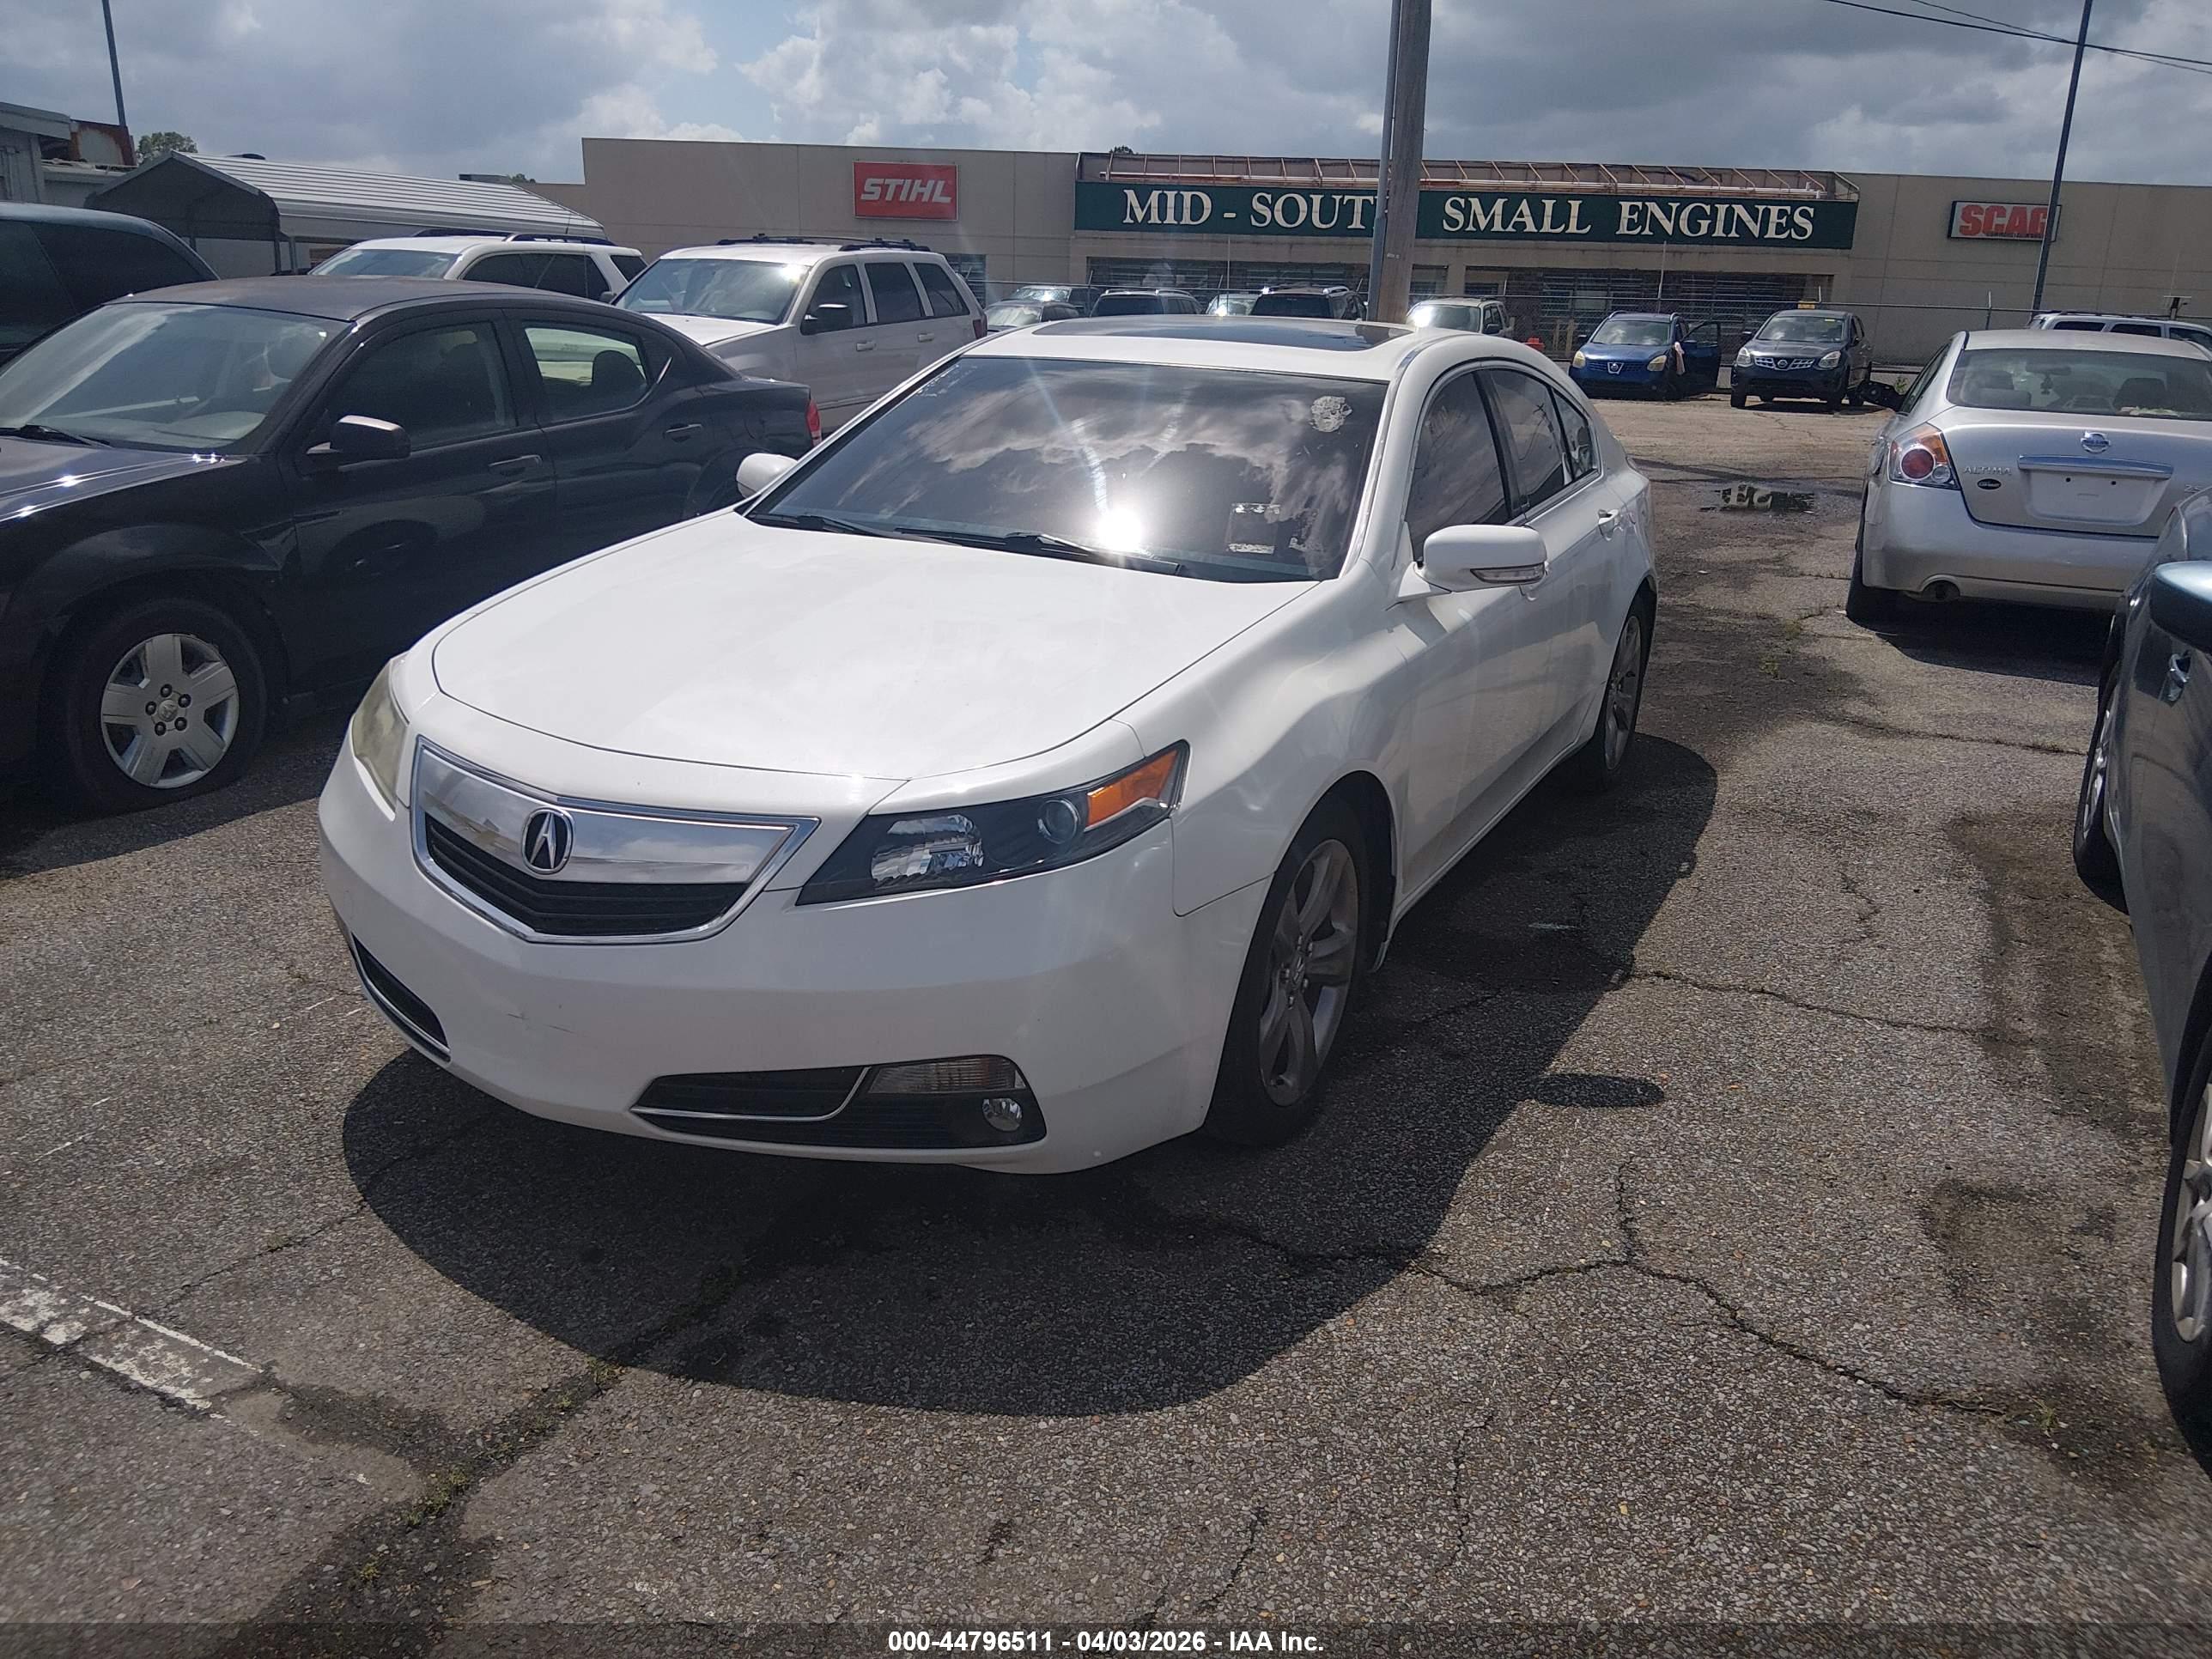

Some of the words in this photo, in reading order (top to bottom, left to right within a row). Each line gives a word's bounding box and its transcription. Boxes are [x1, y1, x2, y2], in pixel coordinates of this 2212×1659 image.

[860, 178, 951, 204] STIHL
[1122, 189, 1212, 225] MID
[1250, 191, 1376, 229] SOUT
[1443, 197, 1593, 234] SMALL
[1615, 200, 1815, 240] ENGINES
